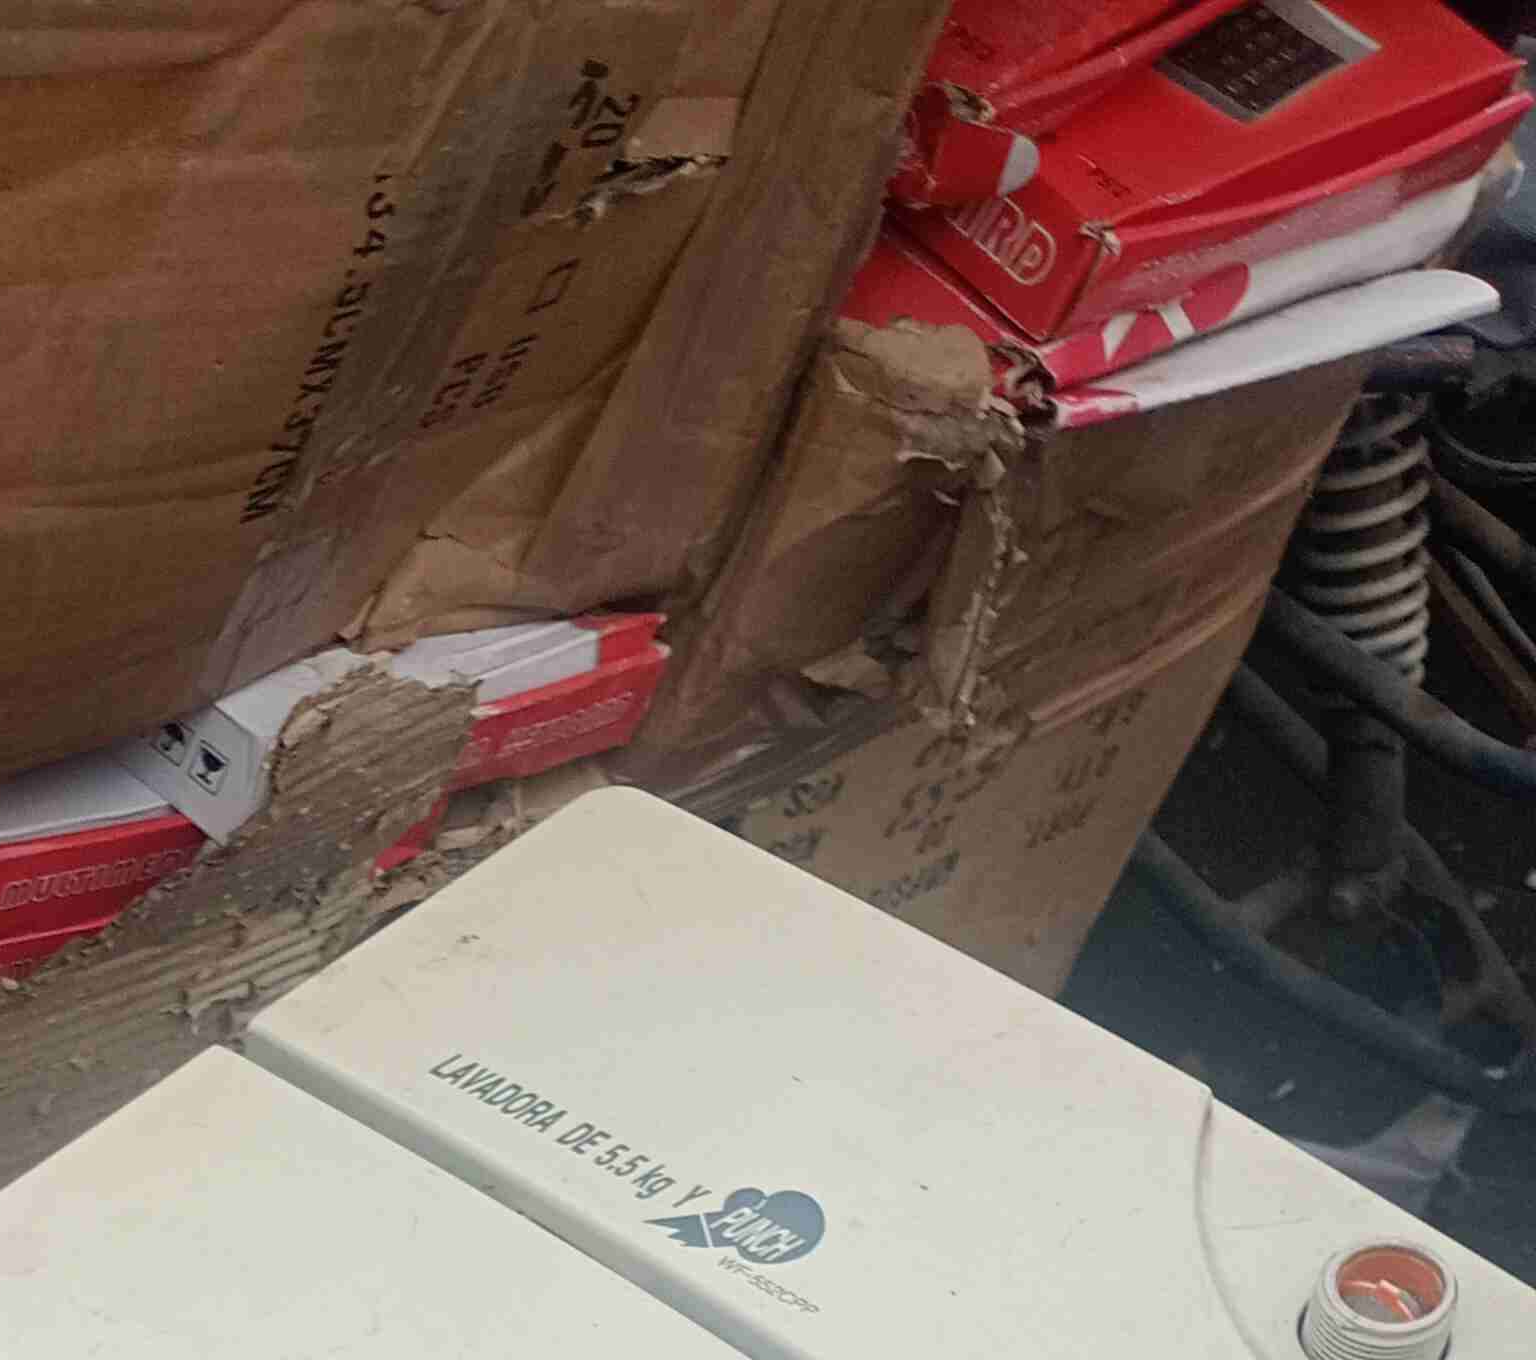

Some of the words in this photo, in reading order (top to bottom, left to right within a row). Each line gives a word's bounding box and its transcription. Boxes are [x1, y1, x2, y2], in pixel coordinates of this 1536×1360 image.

[429, 1053, 568, 1133] LAVADORA
[555, 1122, 612, 1155] DE
[593, 1144, 650, 1177] 5.5
[630, 1164, 677, 1200] kg
[709, 1207, 807, 1262] PUNCH
